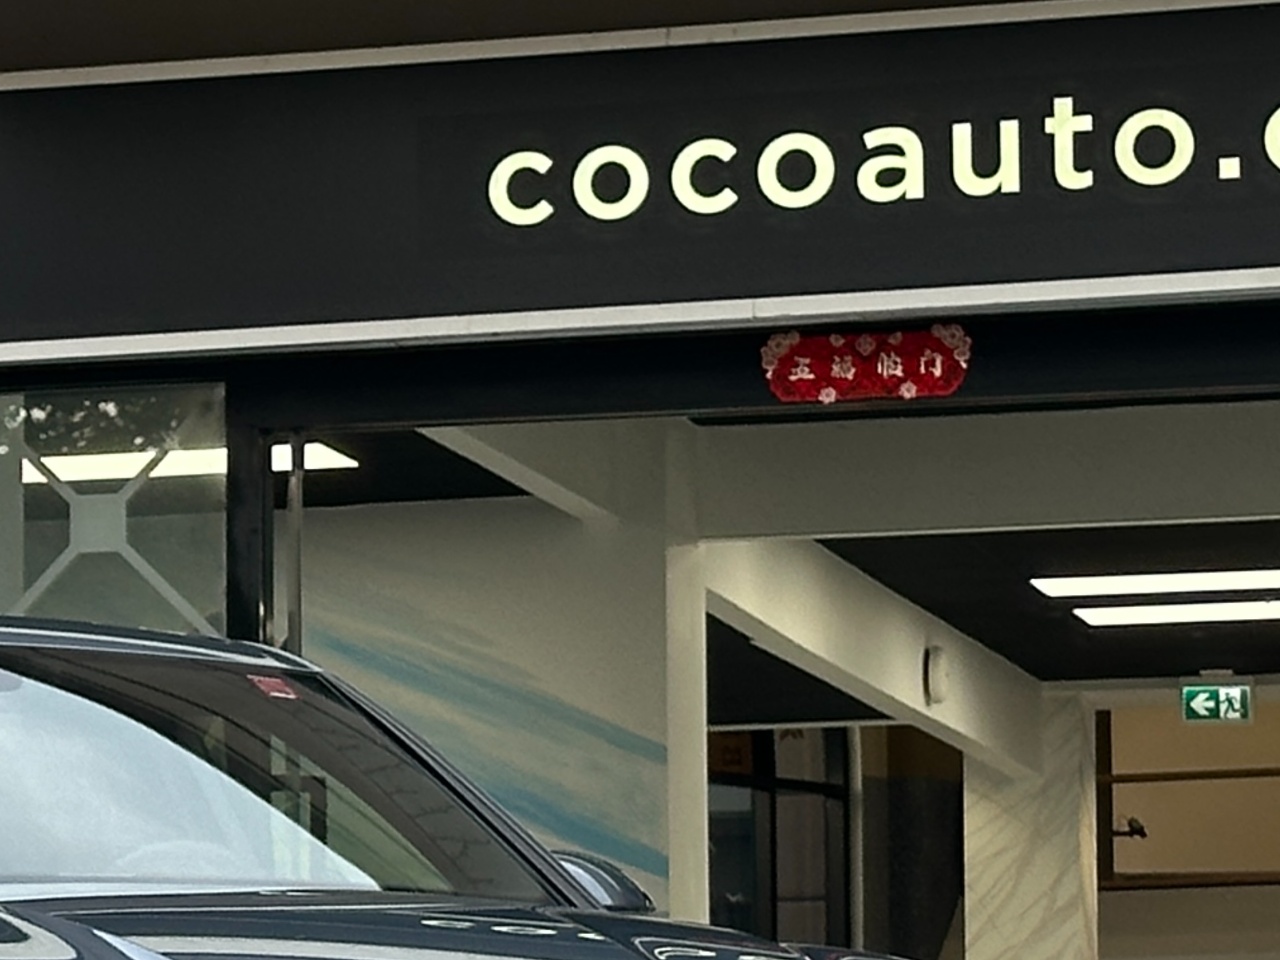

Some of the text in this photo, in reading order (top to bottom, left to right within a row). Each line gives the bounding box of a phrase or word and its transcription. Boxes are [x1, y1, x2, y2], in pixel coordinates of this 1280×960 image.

[489, 97, 1280, 226] cocoauto.
[788, 350, 943, 381] 五福临门
